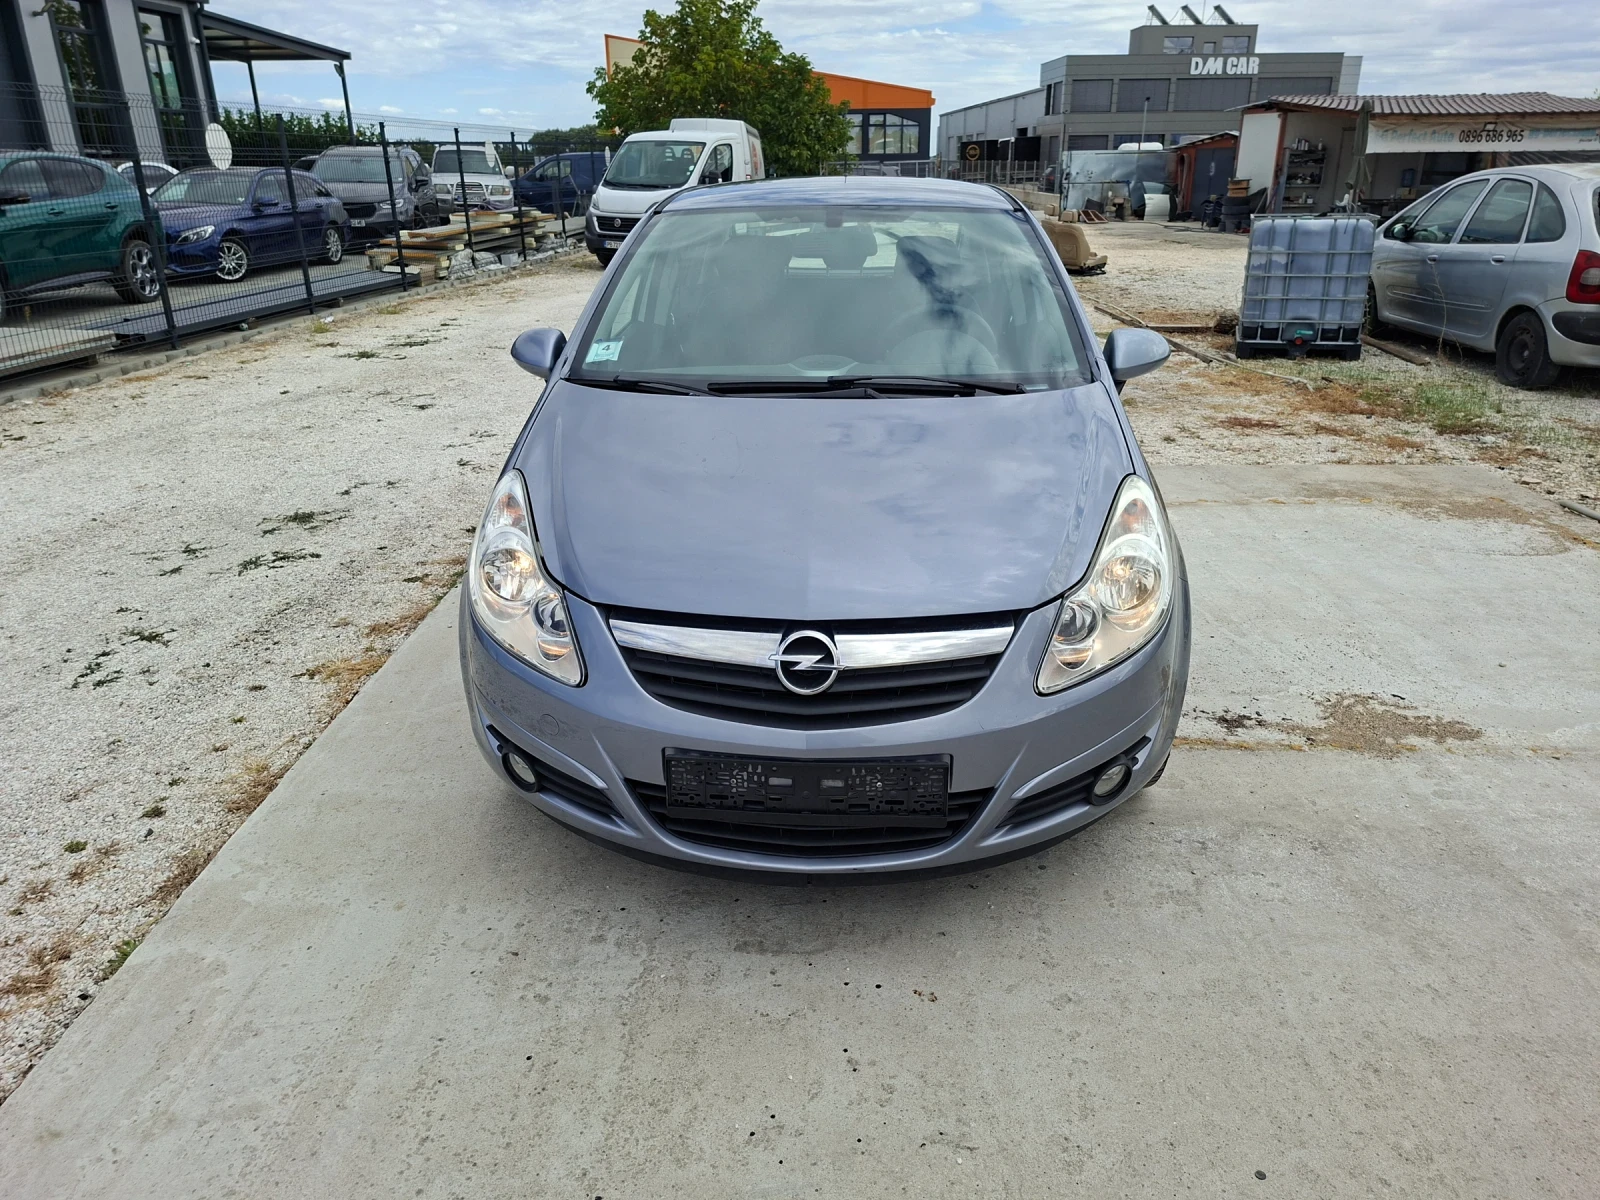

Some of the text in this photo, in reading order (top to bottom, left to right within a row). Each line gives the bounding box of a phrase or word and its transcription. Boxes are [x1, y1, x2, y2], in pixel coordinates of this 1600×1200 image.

[1190, 56, 1260, 75] DM CAR
[1458, 129, 1483, 143] 0896
[1485, 130, 1504, 143] 686
[1505, 129, 1525, 143] 965
[601, 344, 611, 352] 4
